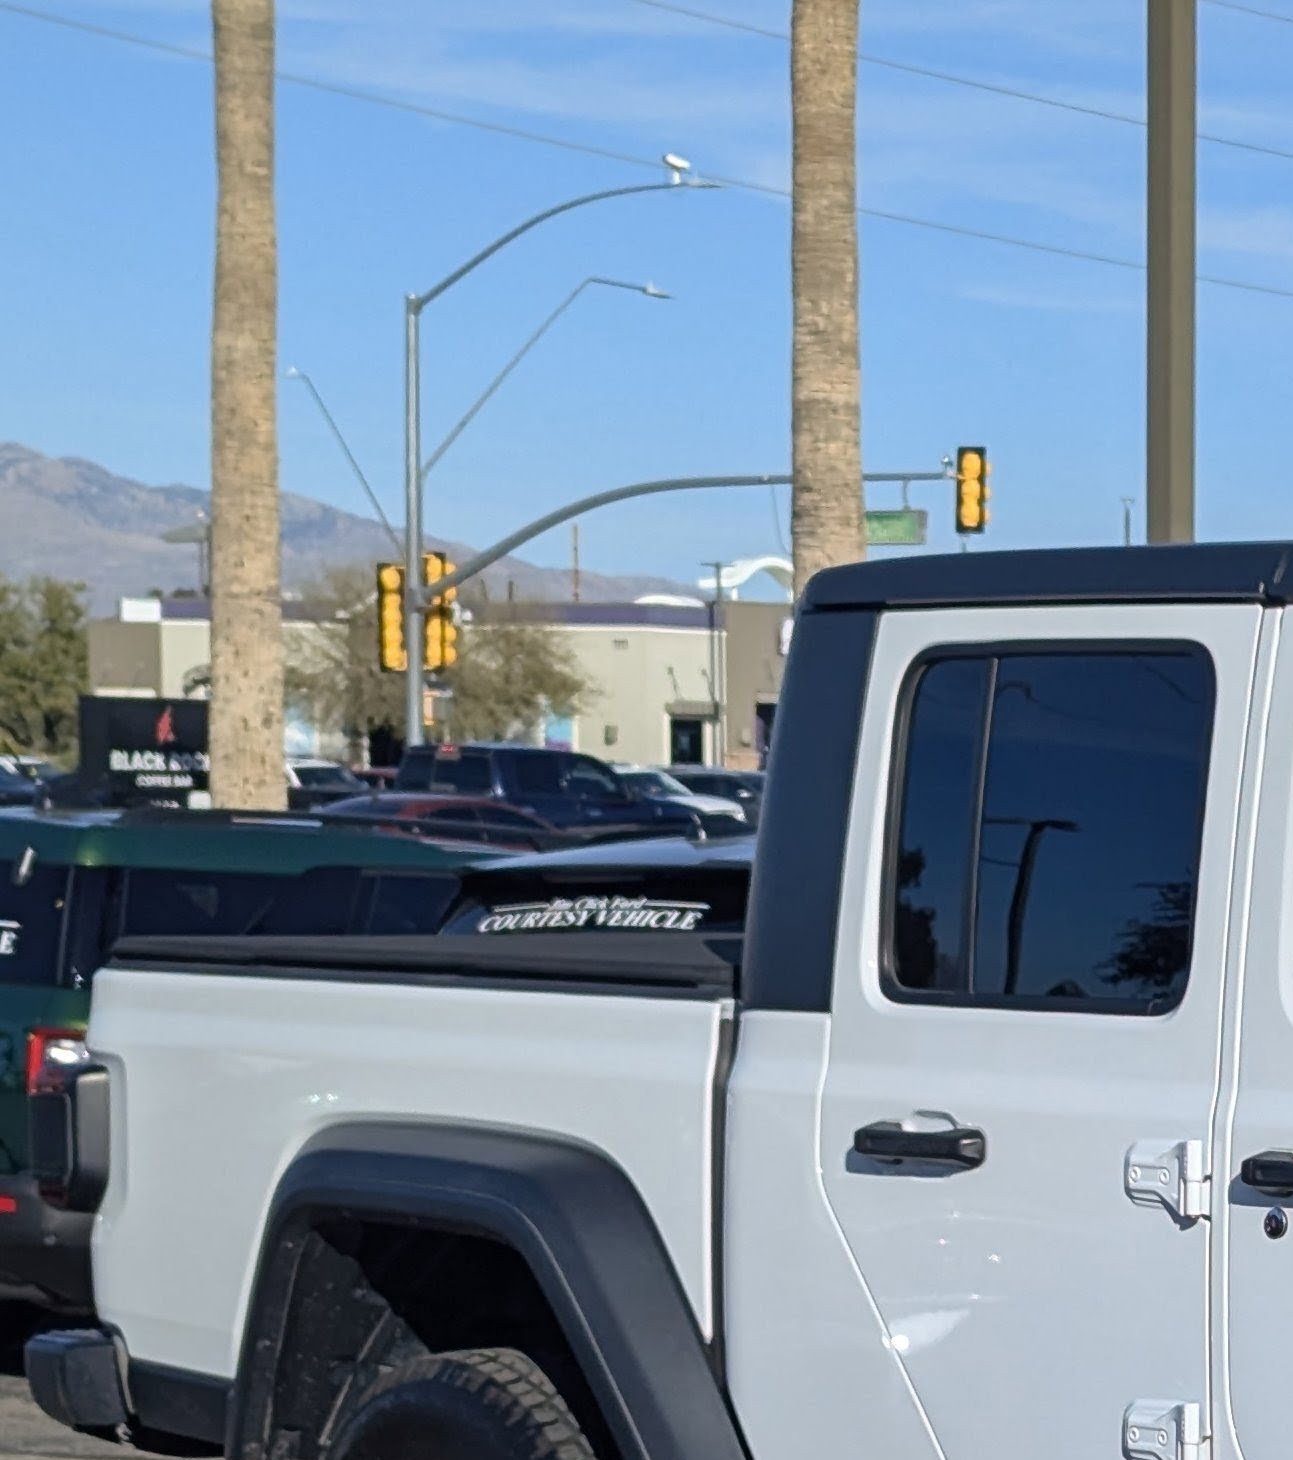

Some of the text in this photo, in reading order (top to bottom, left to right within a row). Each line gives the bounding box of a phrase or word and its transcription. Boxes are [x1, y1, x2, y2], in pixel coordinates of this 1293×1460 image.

[109, 749, 166, 770] BLACK
[479, 909, 702, 932] COURTESY VEHICLE
